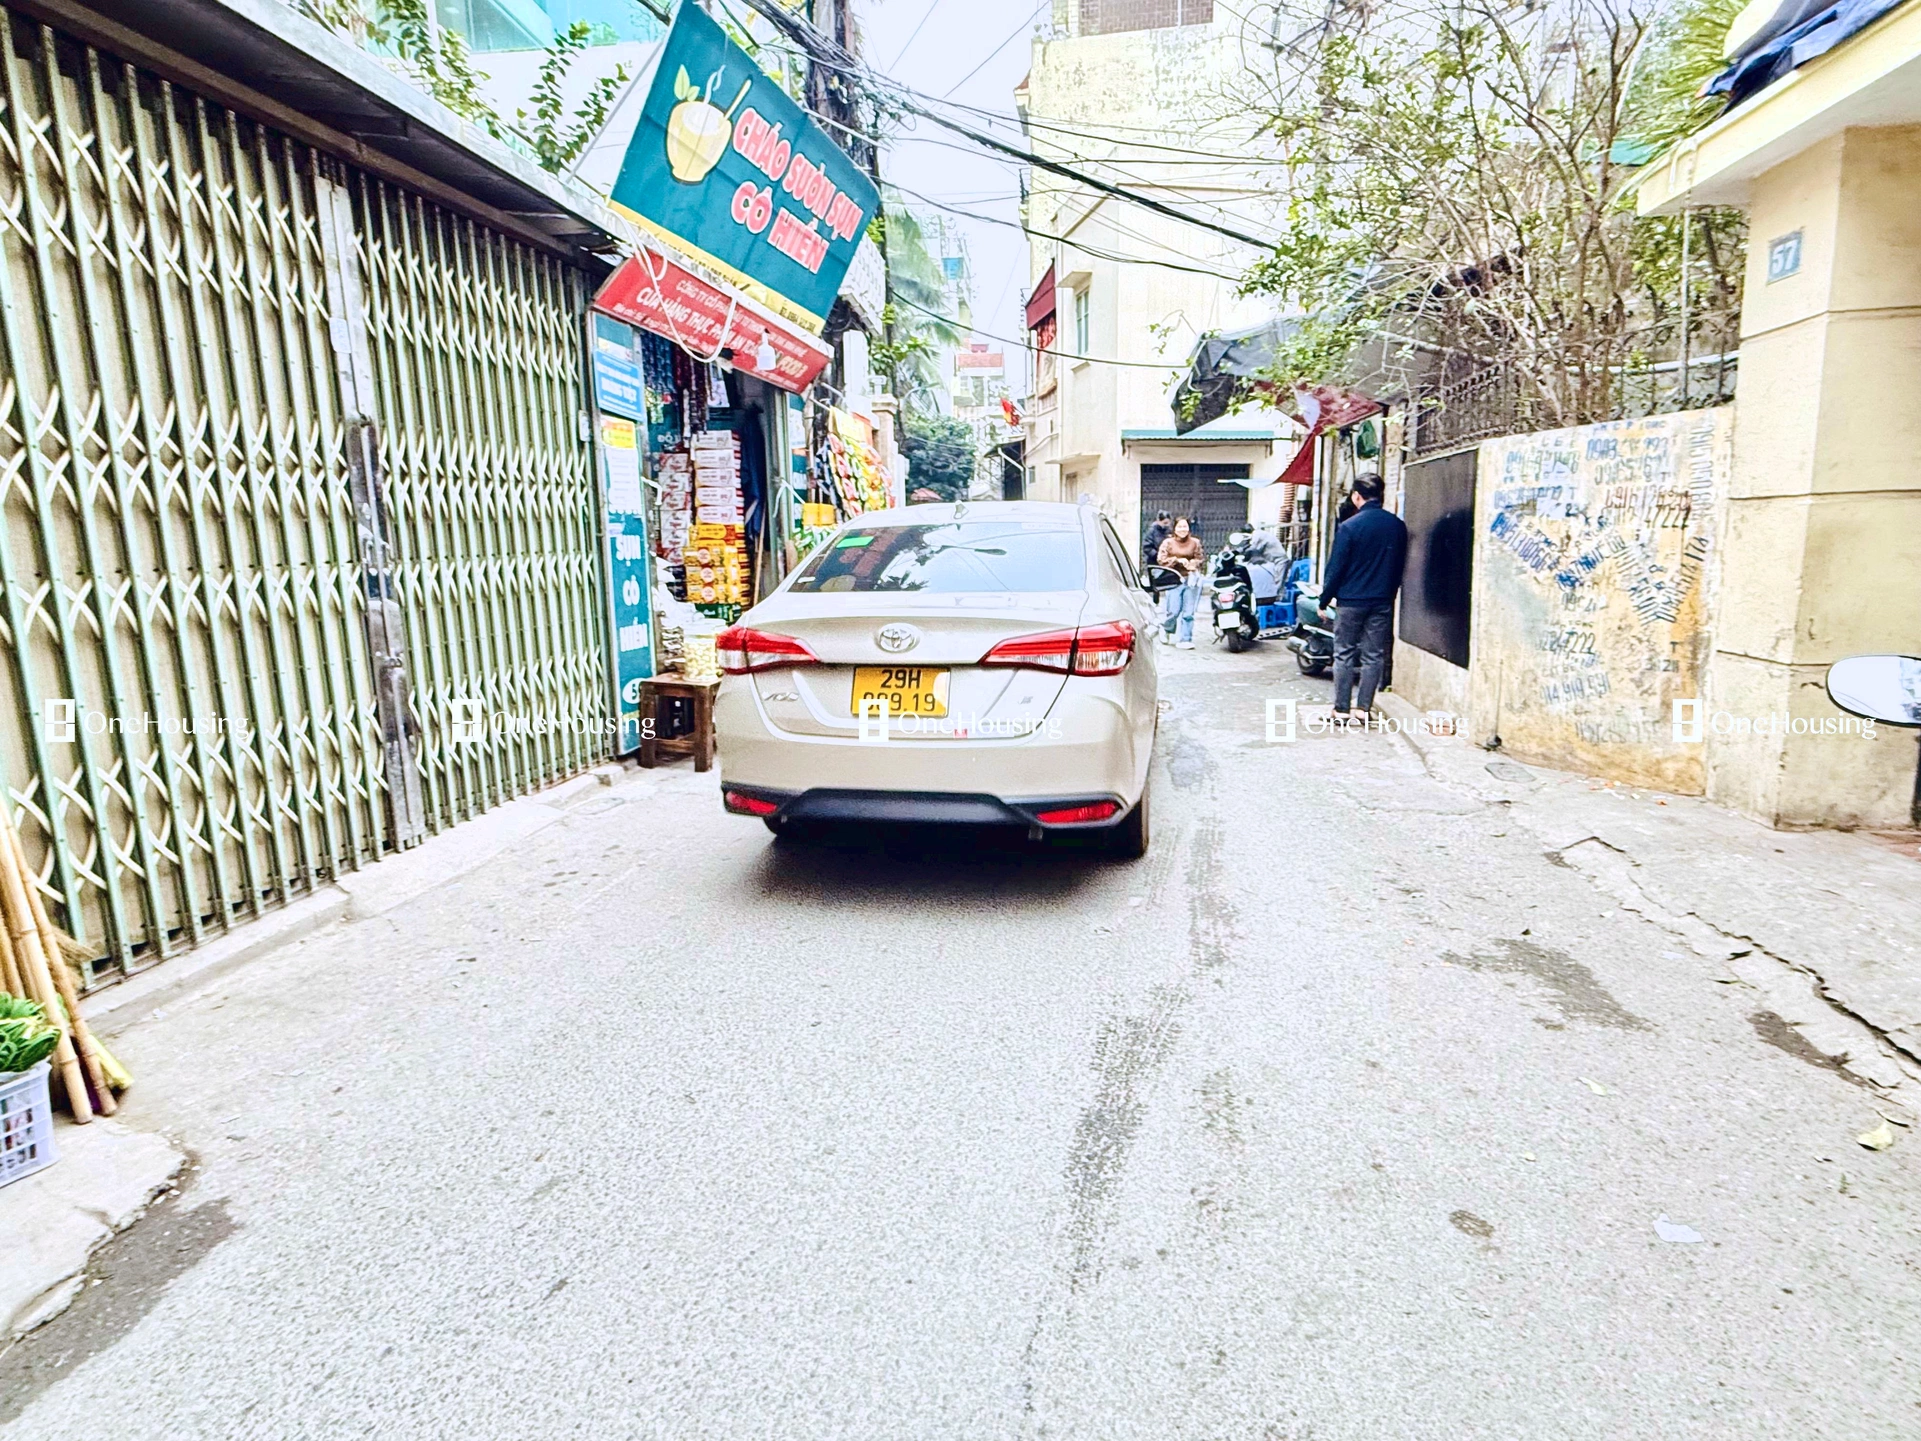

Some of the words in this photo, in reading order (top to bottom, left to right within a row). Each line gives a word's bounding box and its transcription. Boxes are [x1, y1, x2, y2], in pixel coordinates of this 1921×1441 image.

[733, 107, 791, 181] CHÁO
[825, 191, 864, 242] SỤN
[731, 181, 773, 234] CÔ
[1772, 239, 1798, 274] 57
[685, 311, 716, 334] THỰC
[616, 535, 641, 566] SỤN
[880, 669, 921, 689] 29H
